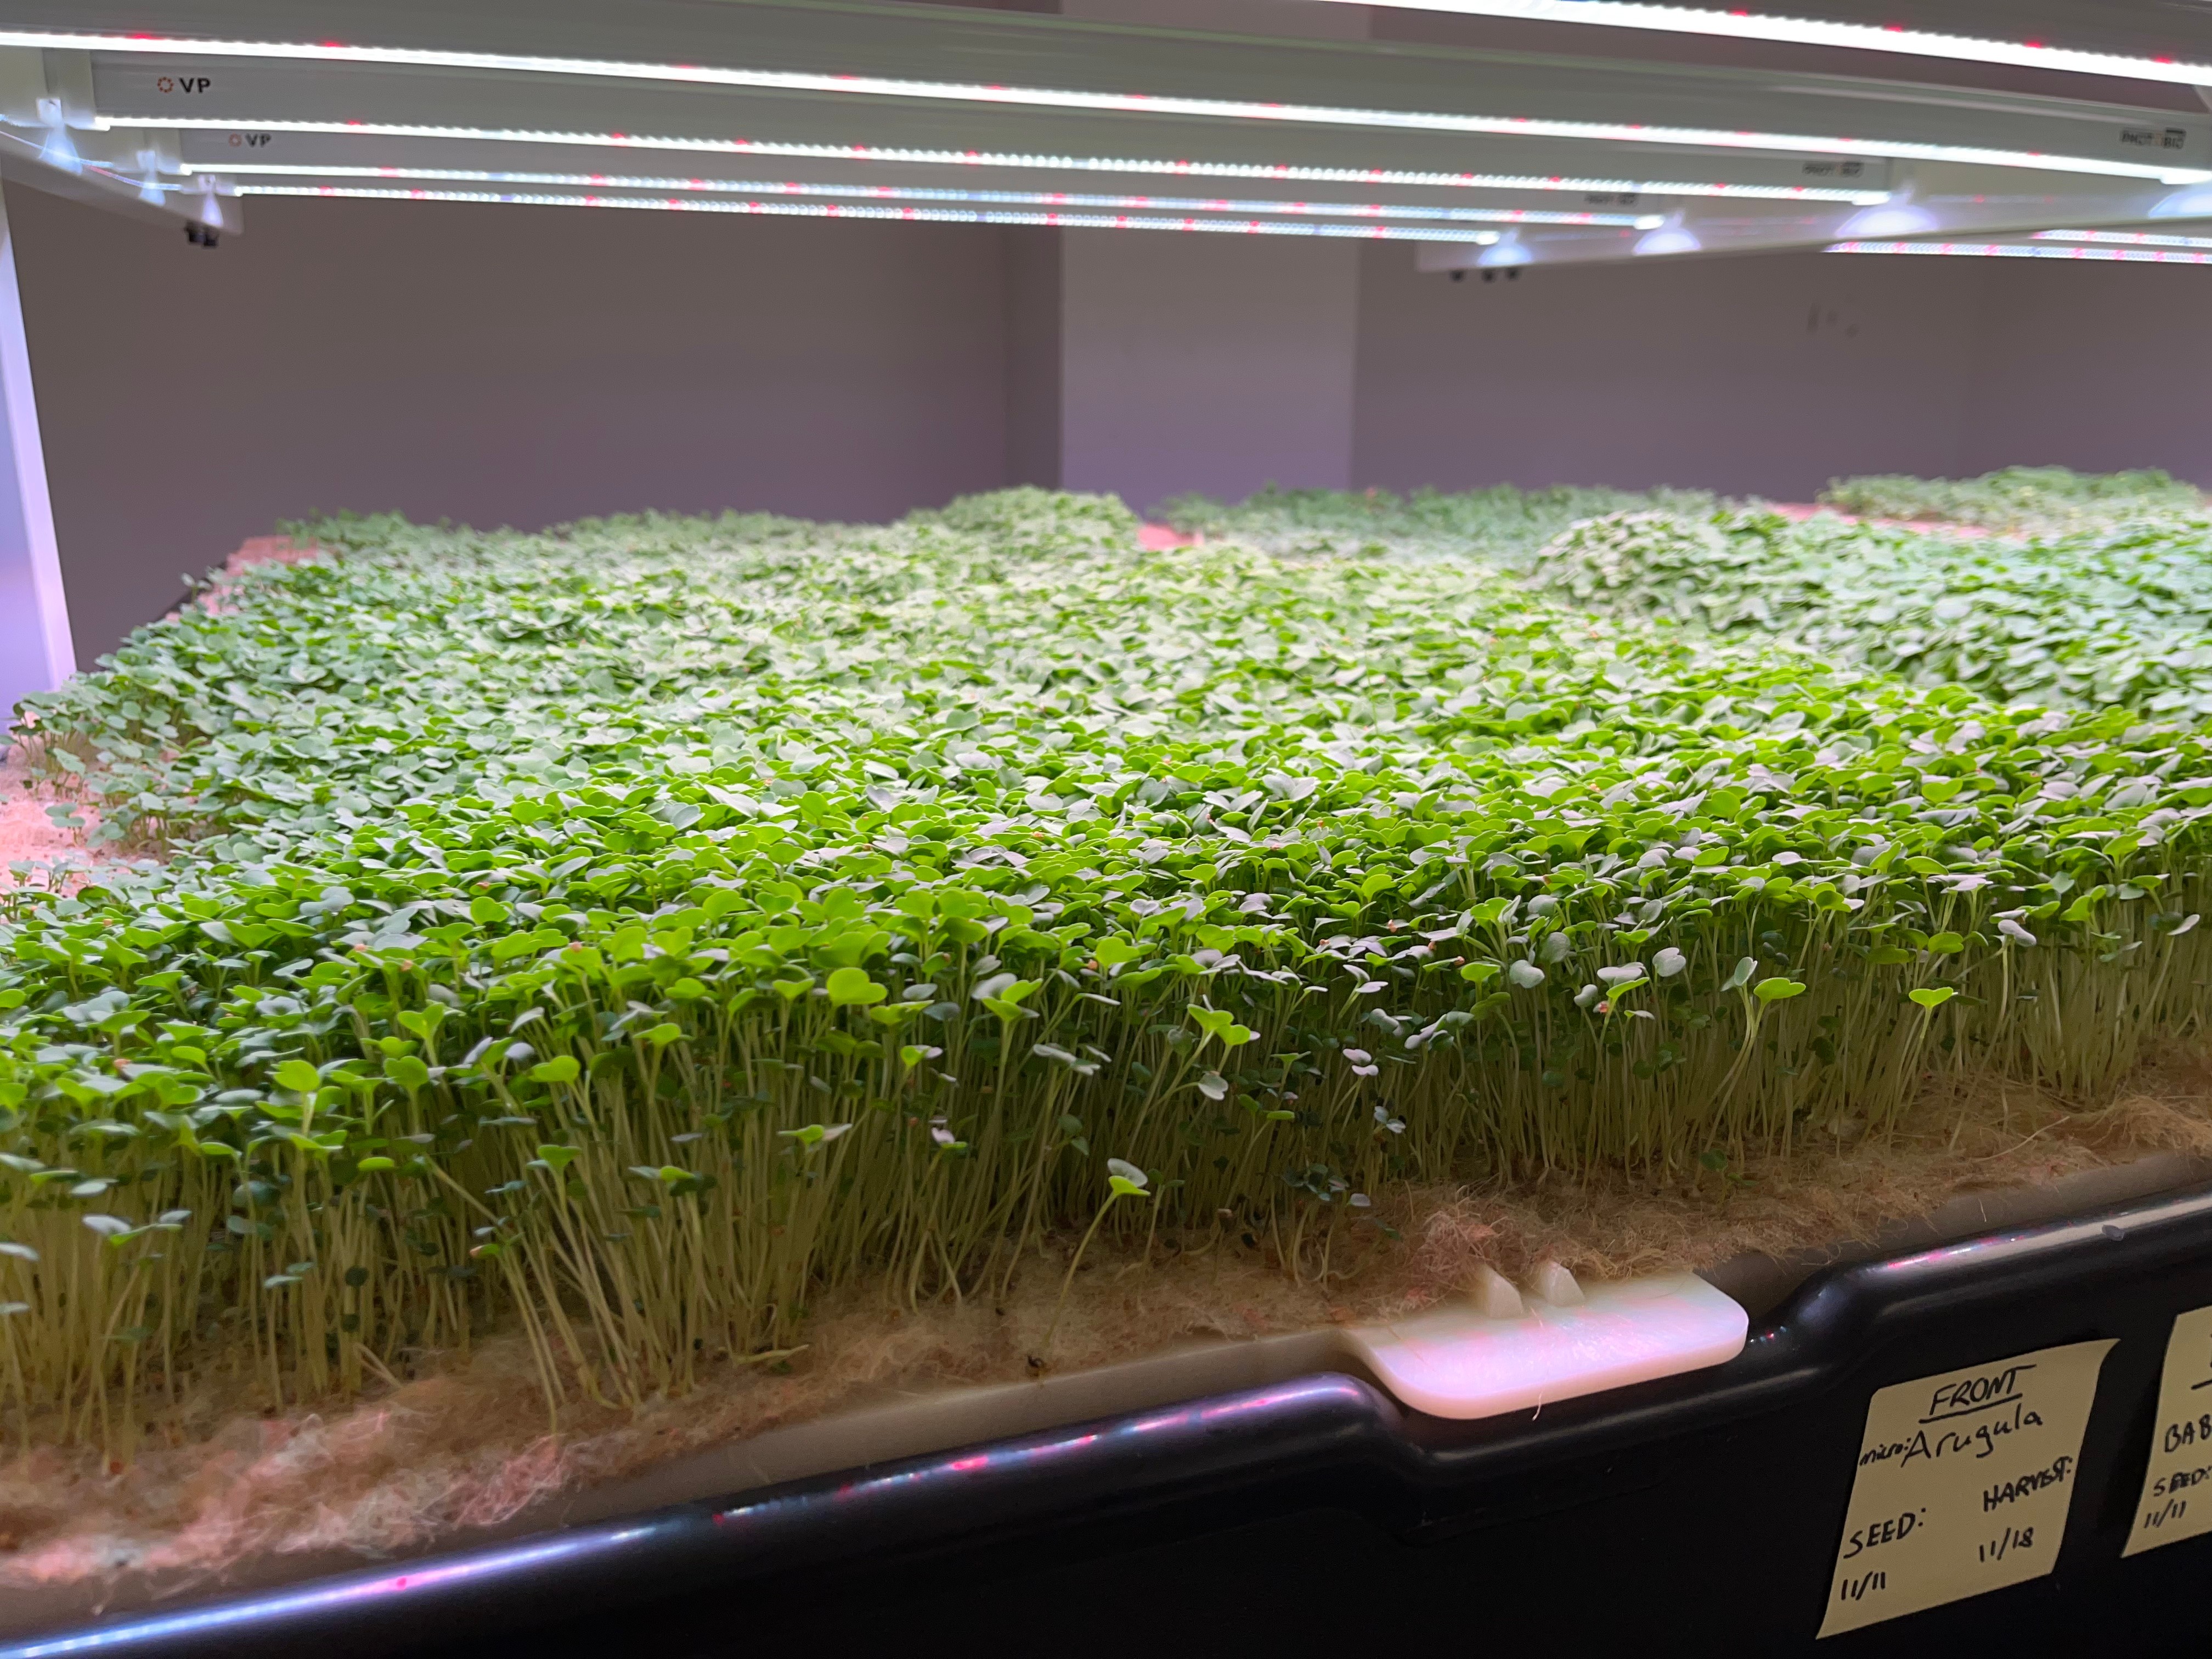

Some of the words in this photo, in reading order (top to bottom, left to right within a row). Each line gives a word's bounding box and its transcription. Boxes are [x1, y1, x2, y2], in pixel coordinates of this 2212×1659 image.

[179, 77, 211, 93] VP
[245, 133, 272, 148] VP
[1929, 1364, 2037, 1415] FRONT
[1900, 1403, 2044, 1468] Arugula
[1983, 1456, 2073, 1512] HARVEST:
[2144, 1499, 2187, 1528] 11/11
[1843, 1508, 1926, 1559] SEED:
[1979, 1527, 2034, 1562] 11/18
[1841, 1571, 1886, 1601] 11/11
